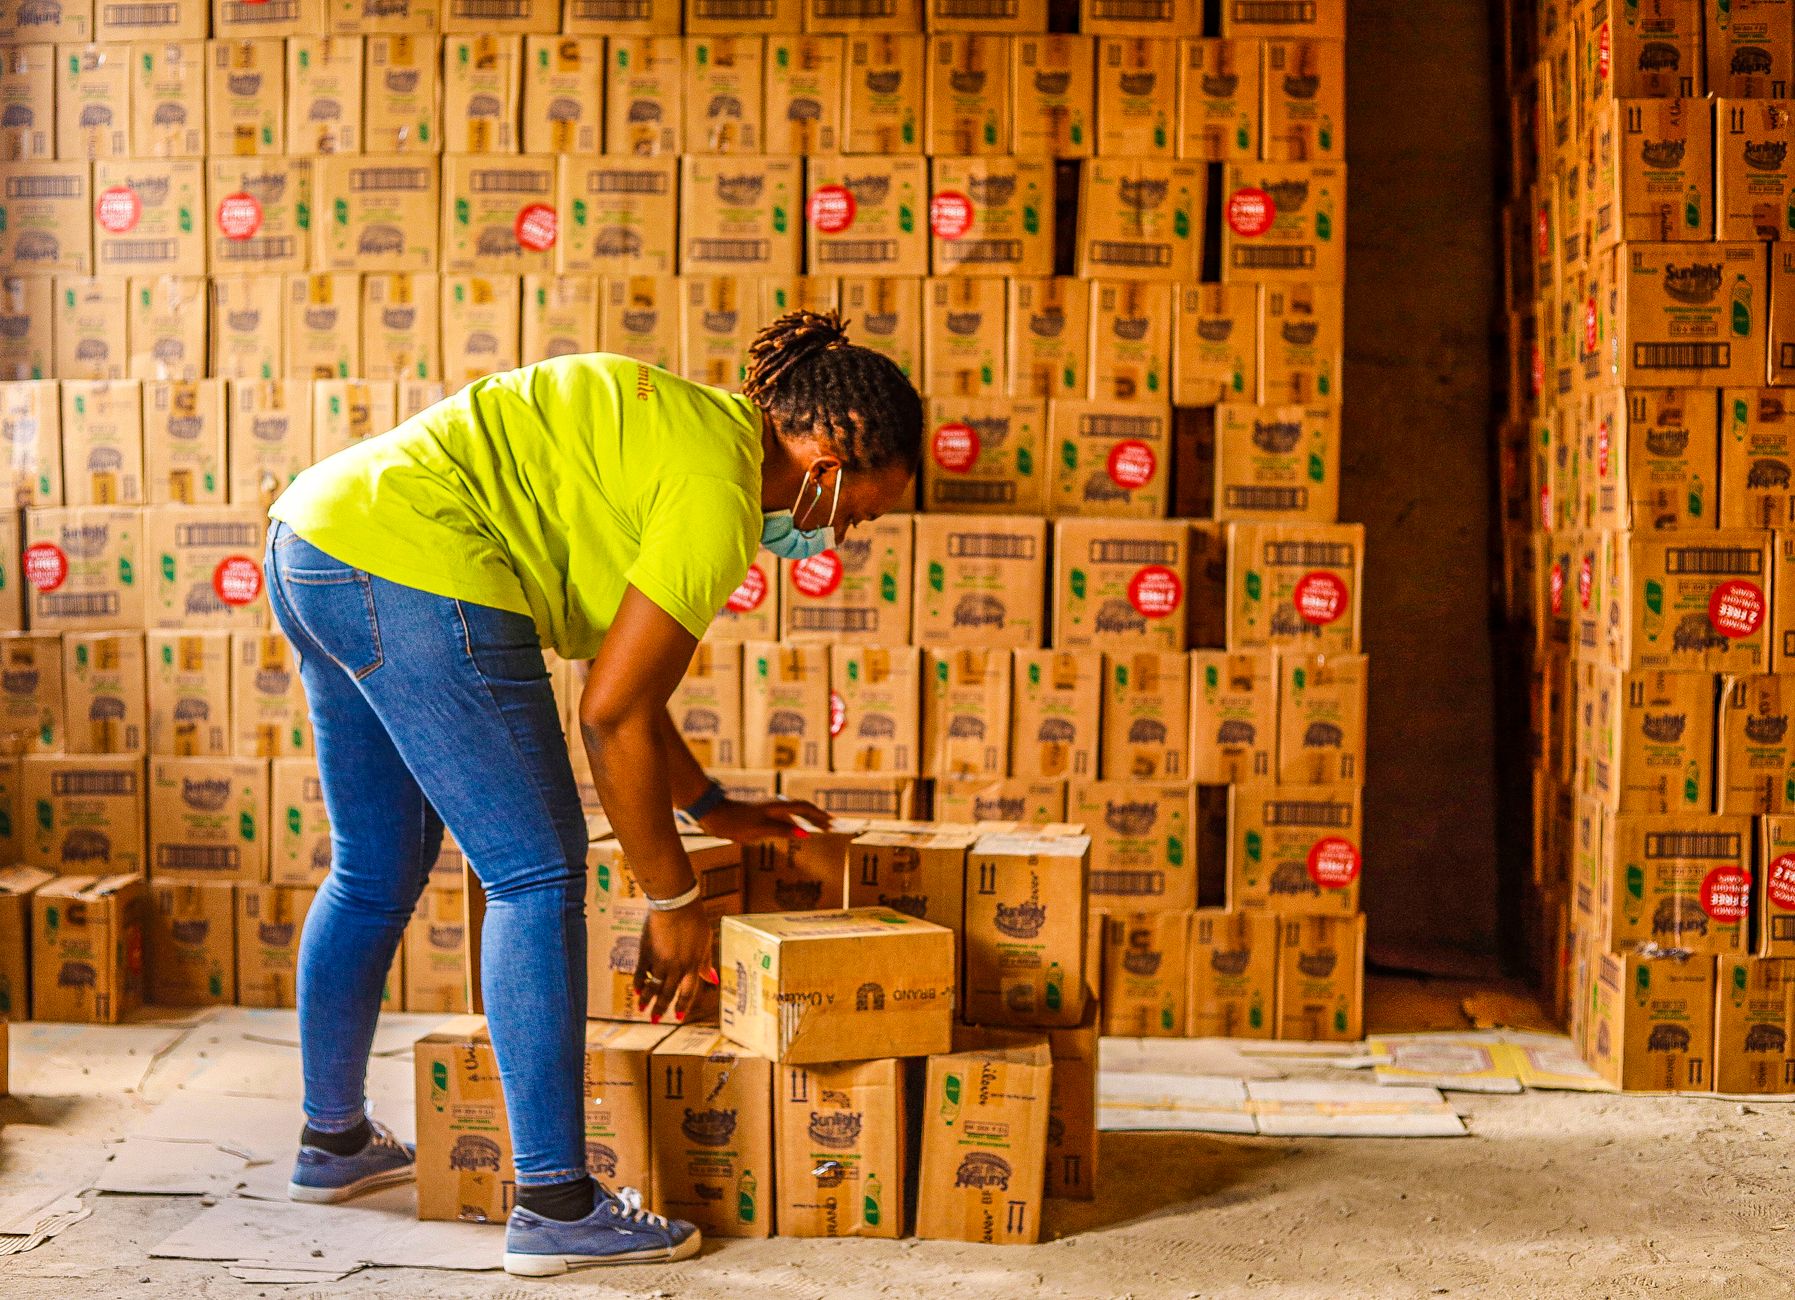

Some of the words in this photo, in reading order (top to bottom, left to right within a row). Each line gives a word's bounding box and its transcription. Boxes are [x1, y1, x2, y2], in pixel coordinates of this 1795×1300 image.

[1664, 262, 1724, 283] Sunlight
[1719, 602, 1748, 621] FREE
[1747, 611, 1758, 625] 2
[1774, 865, 1784, 879] 2
[1711, 892, 1739, 907] FREE
[826, 993, 836, 1005] A
[892, 986, 937, 1002] BRAND
[684, 1107, 738, 1126] Sunlight
[810, 1111, 864, 1130] Sunlight
[953, 1174, 1009, 1193] Sunlight
